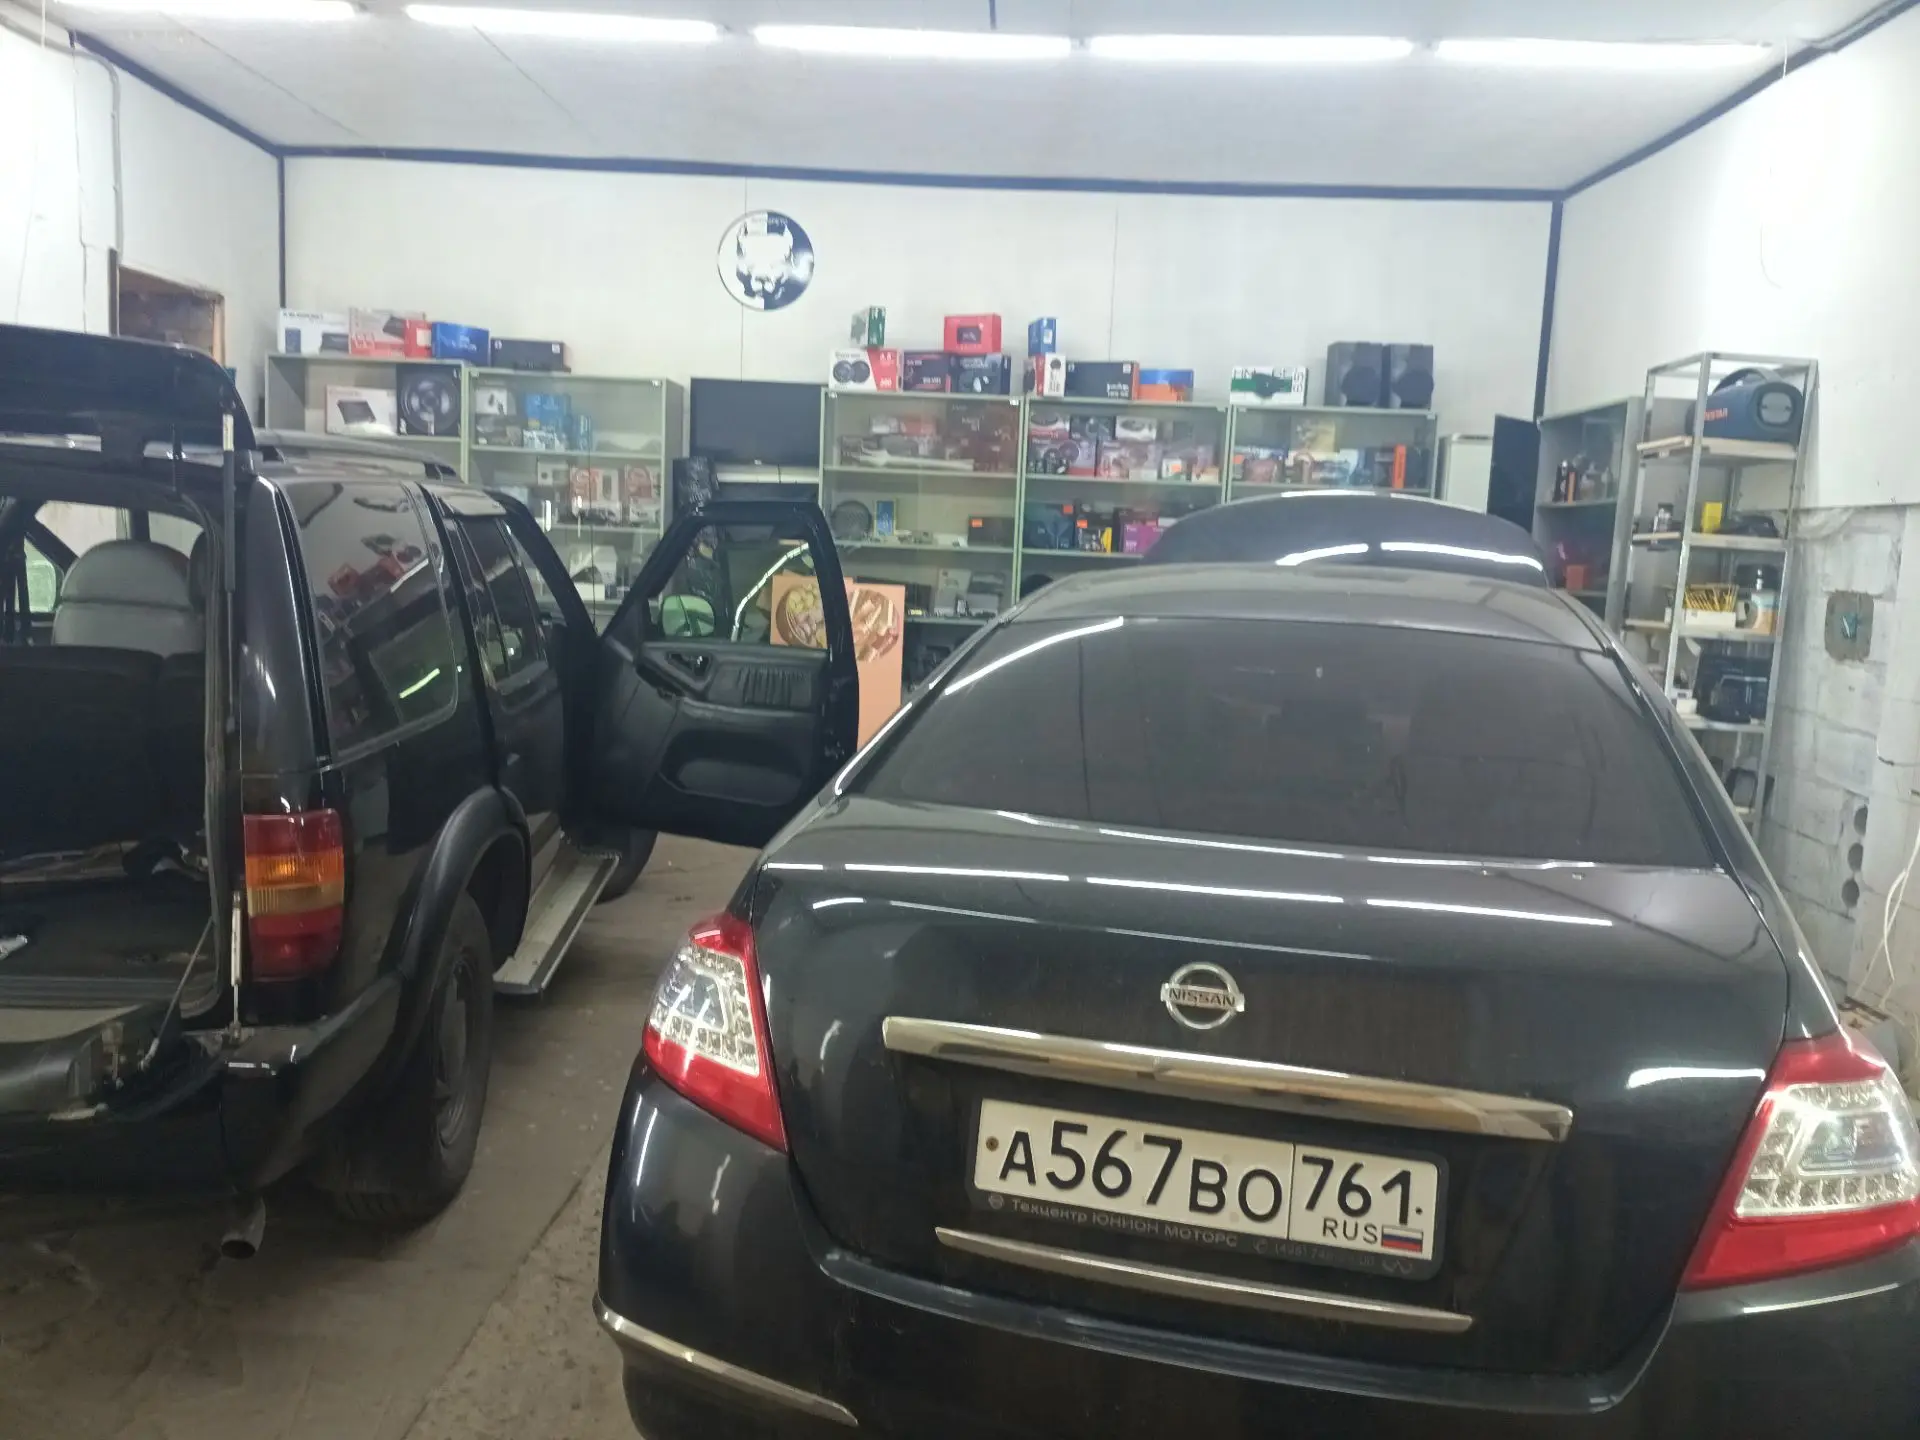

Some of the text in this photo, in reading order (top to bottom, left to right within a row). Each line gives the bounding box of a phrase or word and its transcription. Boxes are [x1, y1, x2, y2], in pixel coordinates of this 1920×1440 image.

[1168, 987, 1238, 1009] NISSAN
[1301, 1154, 1414, 1226] 761
[1012, 1198, 1088, 1224] Техцентр
[1092, 1212, 1160, 1235] ЮНИОН
[1163, 1224, 1240, 1248] МОТОРС
[1322, 1217, 1379, 1245] RUS
